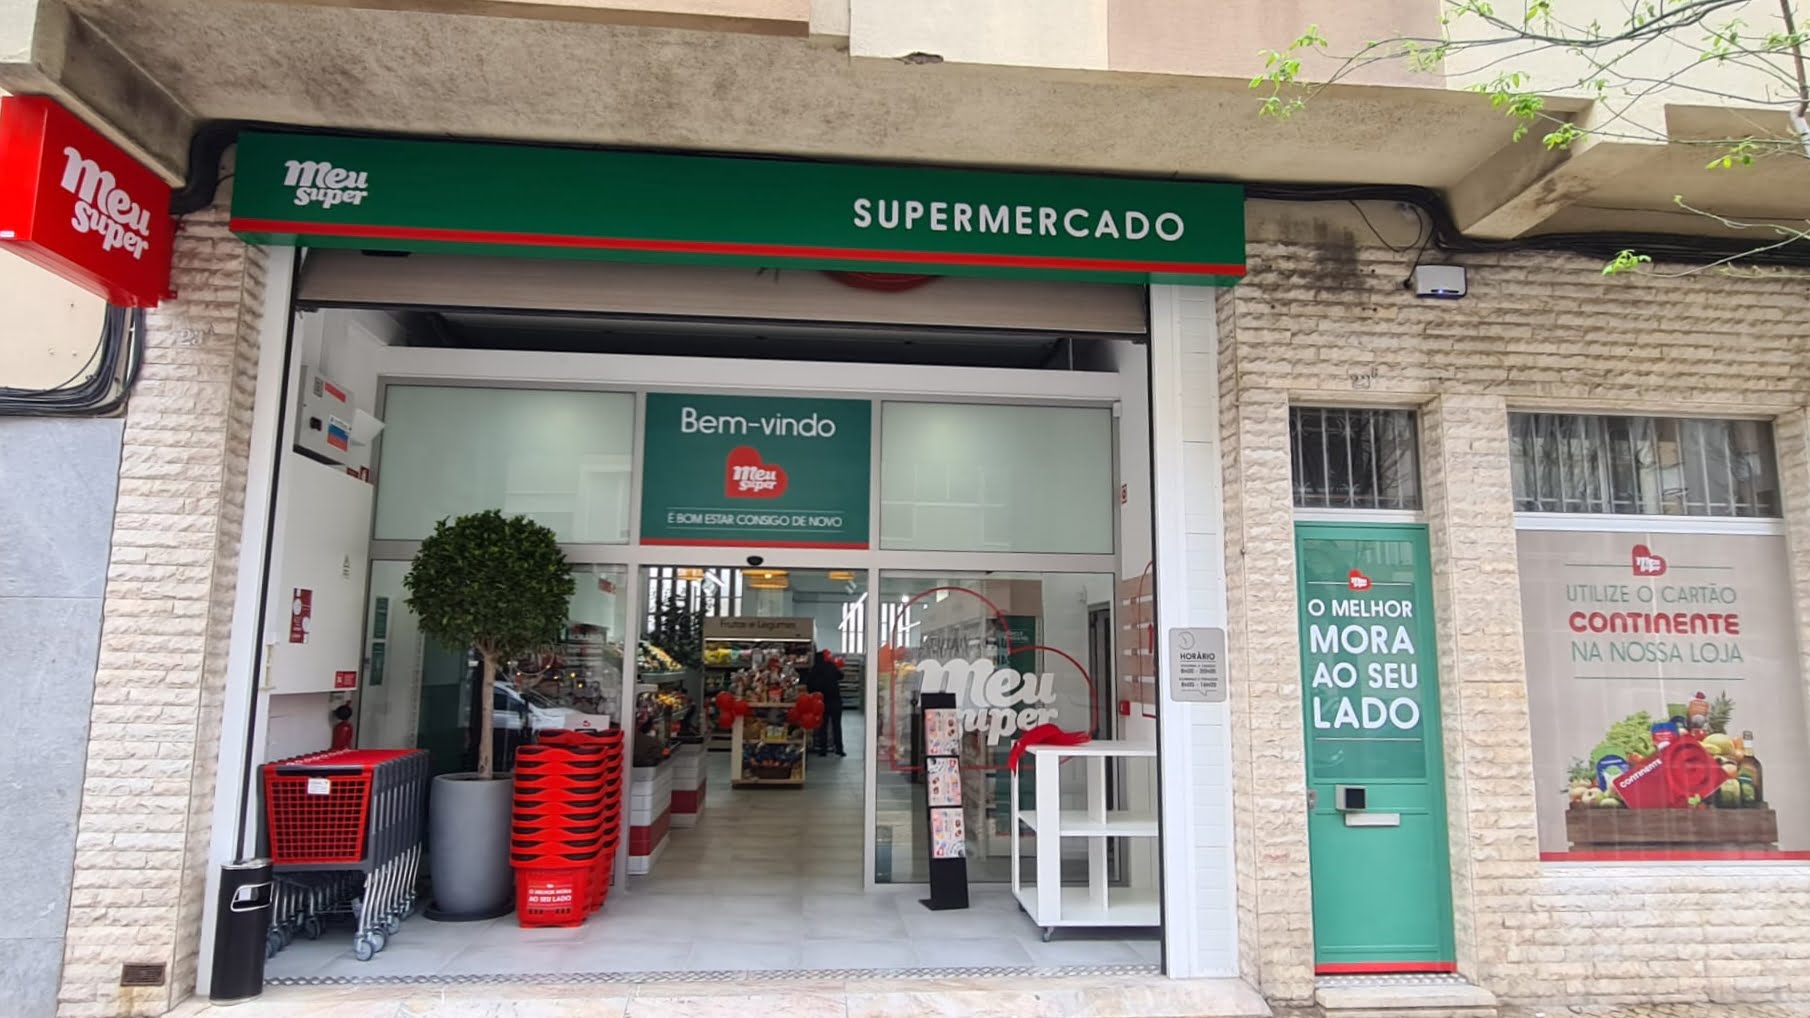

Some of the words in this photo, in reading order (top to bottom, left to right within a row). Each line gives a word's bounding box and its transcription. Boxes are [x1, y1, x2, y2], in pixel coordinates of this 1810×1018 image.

[293, 187, 368, 209] super
[853, 197, 1185, 241] SUPERMERCADO
[681, 406, 837, 437] Bem-vindo
[676, 513, 703, 525] BOM
[704, 513, 735, 525] ESTAR
[735, 514, 791, 526] CONSIGO
[791, 515, 807, 527] DE
[808, 516, 843, 528] NOVO
[1566, 584, 1630, 603] UTILIZE
[1637, 585, 1654, 603] O
[1661, 583, 1737, 604] CARTÃO
[1308, 599, 1325, 616] O
[1332, 599, 1413, 618] MELHOR
[1568, 611, 1740, 635] CONTINENTE
[1309, 624, 1415, 655] MORA
[1571, 640, 1603, 662] NA
[1610, 641, 1684, 663] NOSSA
[1690, 642, 1744, 664] LOJA
[1312, 662, 1357, 688] AO
[1368, 662, 1418, 689] SEU
[1313, 696, 1420, 730] LADO
[957, 706, 1059, 746] uper
